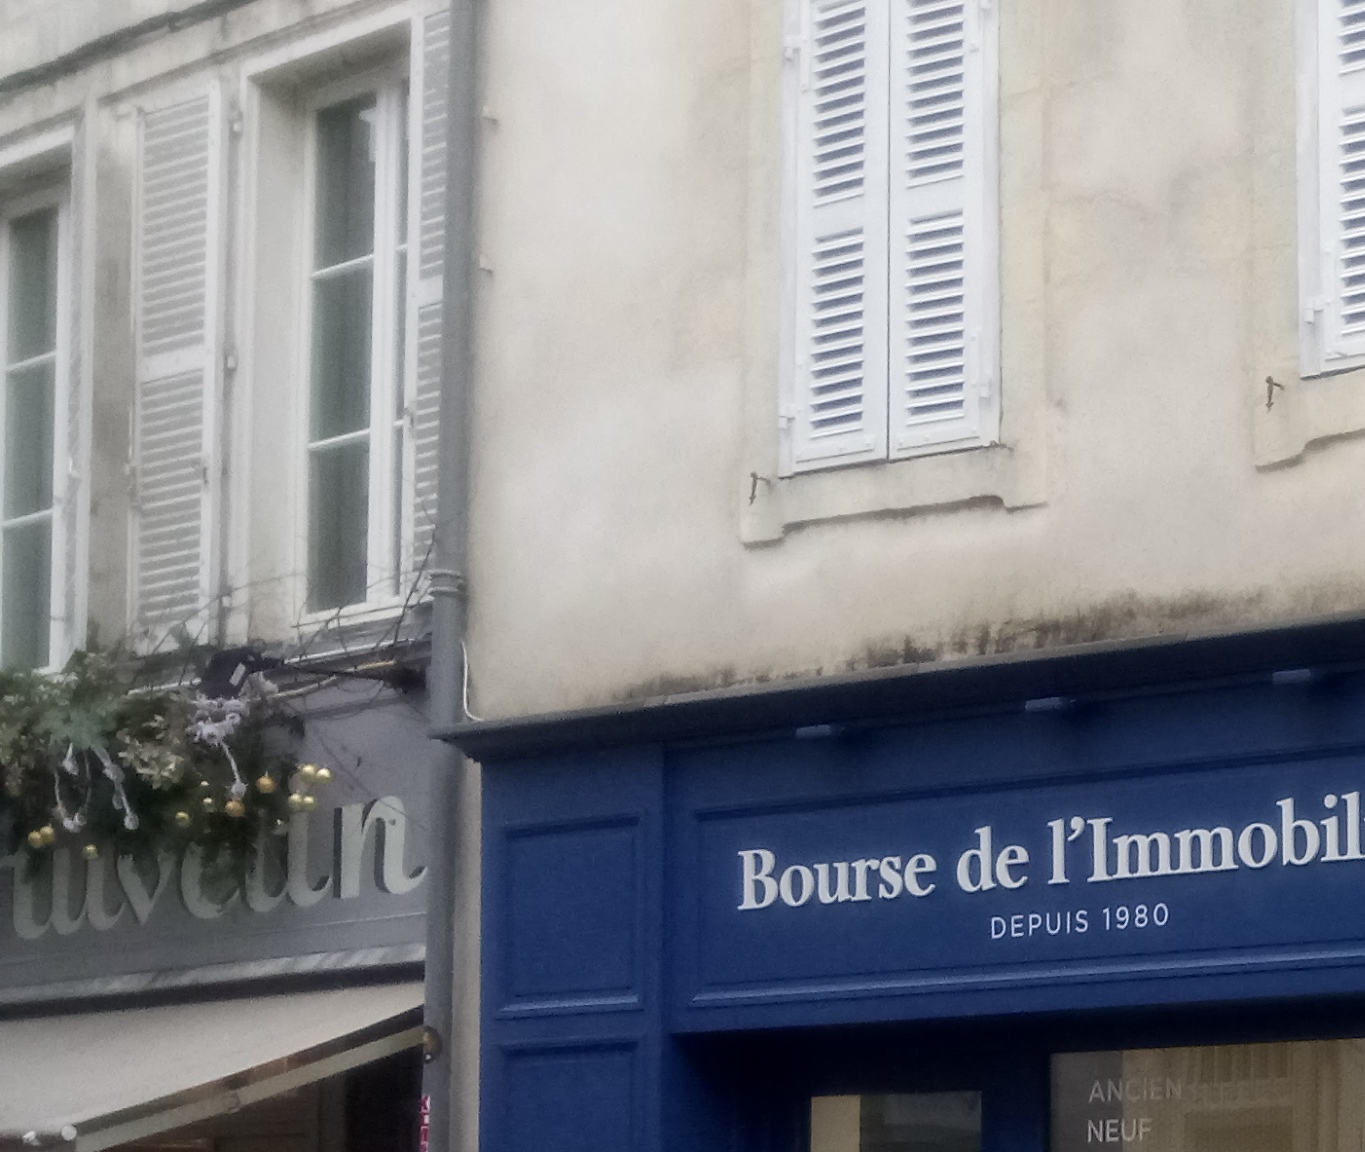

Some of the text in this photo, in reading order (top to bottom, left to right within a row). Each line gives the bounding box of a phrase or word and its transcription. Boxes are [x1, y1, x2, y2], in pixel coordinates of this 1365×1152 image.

[735, 847, 938, 912] Bourse
[956, 825, 1029, 894] de
[990, 902, 1171, 941] DEPUIS 1980
[1088, 1077, 1184, 1104] ANCIEN
[1087, 1117, 1153, 1144] NEUF
